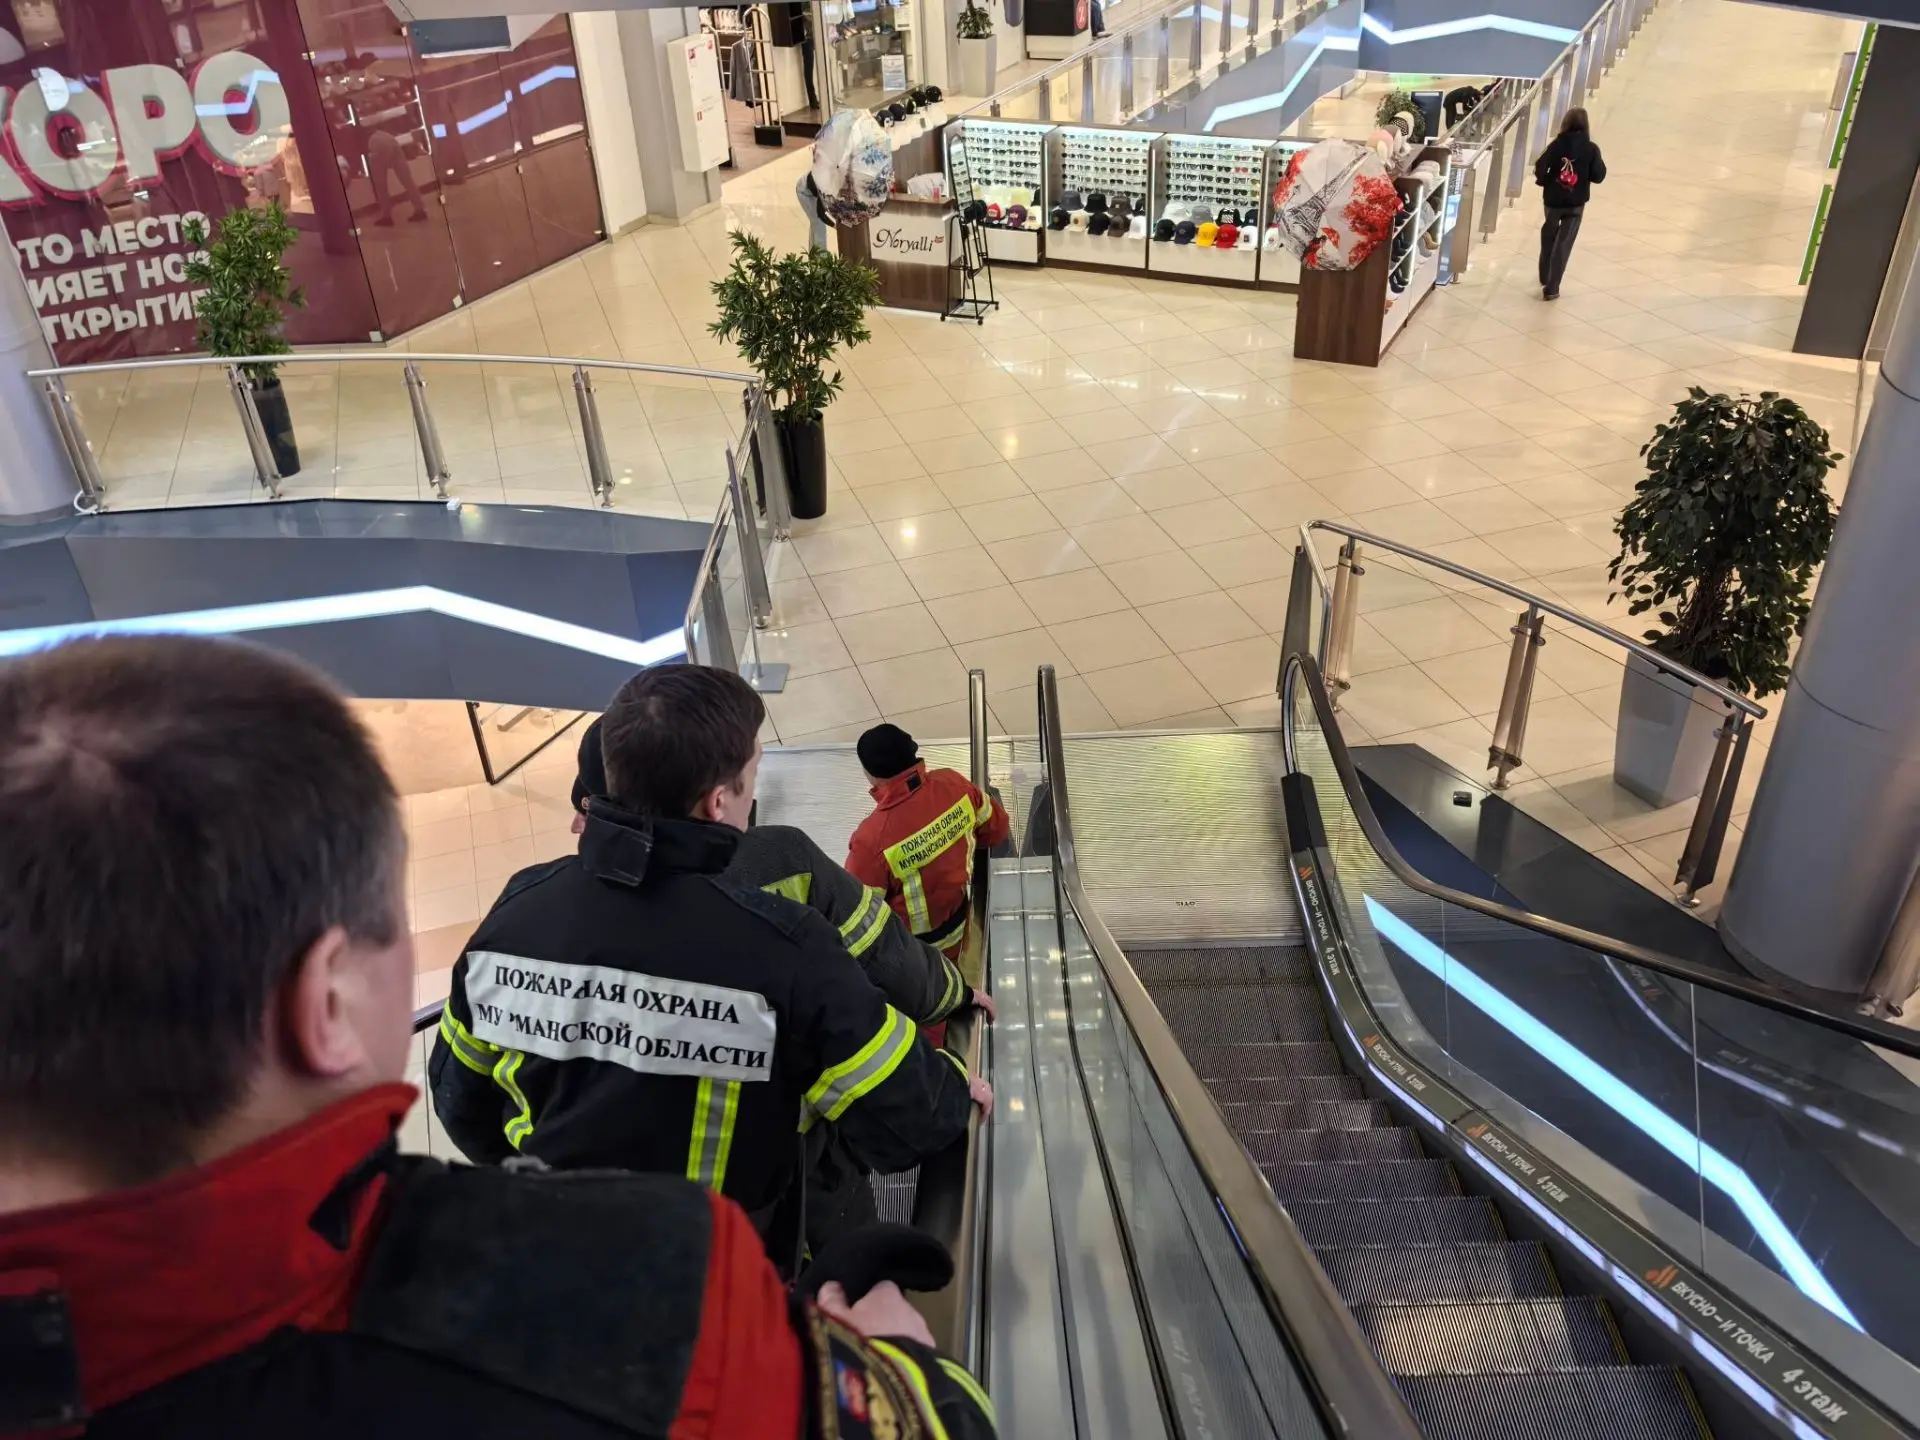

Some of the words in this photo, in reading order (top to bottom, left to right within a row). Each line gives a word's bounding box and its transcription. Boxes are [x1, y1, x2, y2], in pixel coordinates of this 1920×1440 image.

[12, 233, 73, 269] ТО
[80, 211, 211, 259] МЕСТО
[873, 228, 934, 254] Noryalli
[898, 832, 949, 871] МУРМАНСКОЙ
[947, 814, 971, 840] ОБЛАСТИ
[901, 823, 941, 855] ПОЖАРНАЯ
[940, 806, 963, 829] ОХРАНА
[633, 988, 740, 1025] ОХРАНА
[635, 1035, 768, 1068] ОБЛАСТИ
[1536, 1175, 1551, 1185] 4
[1730, 1326, 1775, 1365] ТОЧКА
[1782, 1368, 1804, 1384] 4
[1793, 1380, 1849, 1423] этаж
